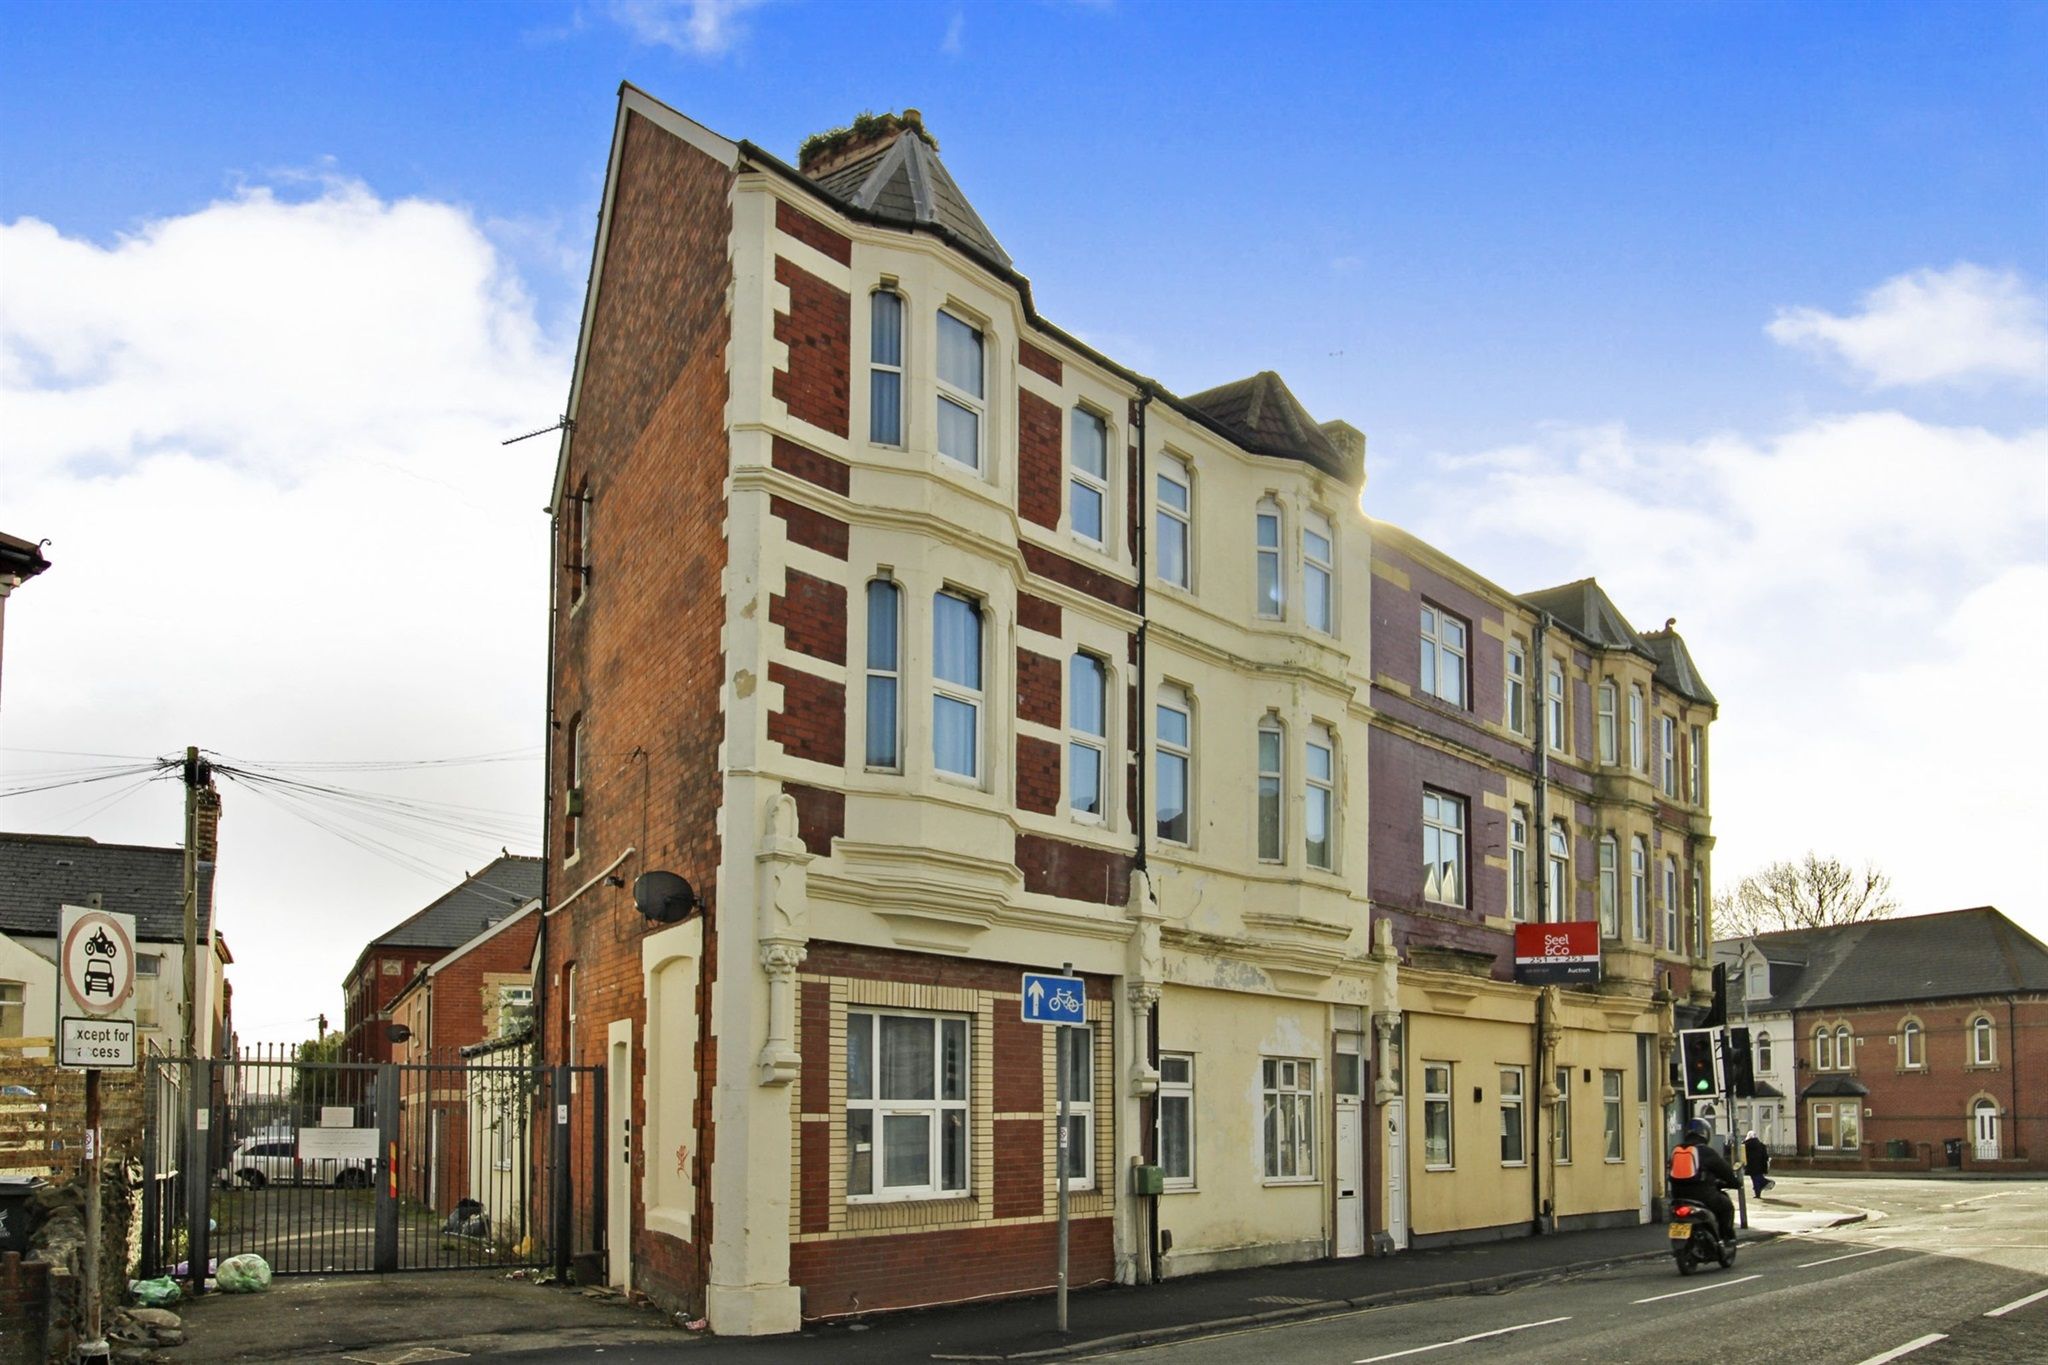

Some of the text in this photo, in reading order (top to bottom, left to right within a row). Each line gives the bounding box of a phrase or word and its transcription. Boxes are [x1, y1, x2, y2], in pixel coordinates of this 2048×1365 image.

[1544, 934, 1569, 945] Seel
[1545, 945, 1570, 956] &Co
[77, 1028, 129, 1043] xcept for
[77, 1047, 120, 1058] acess
